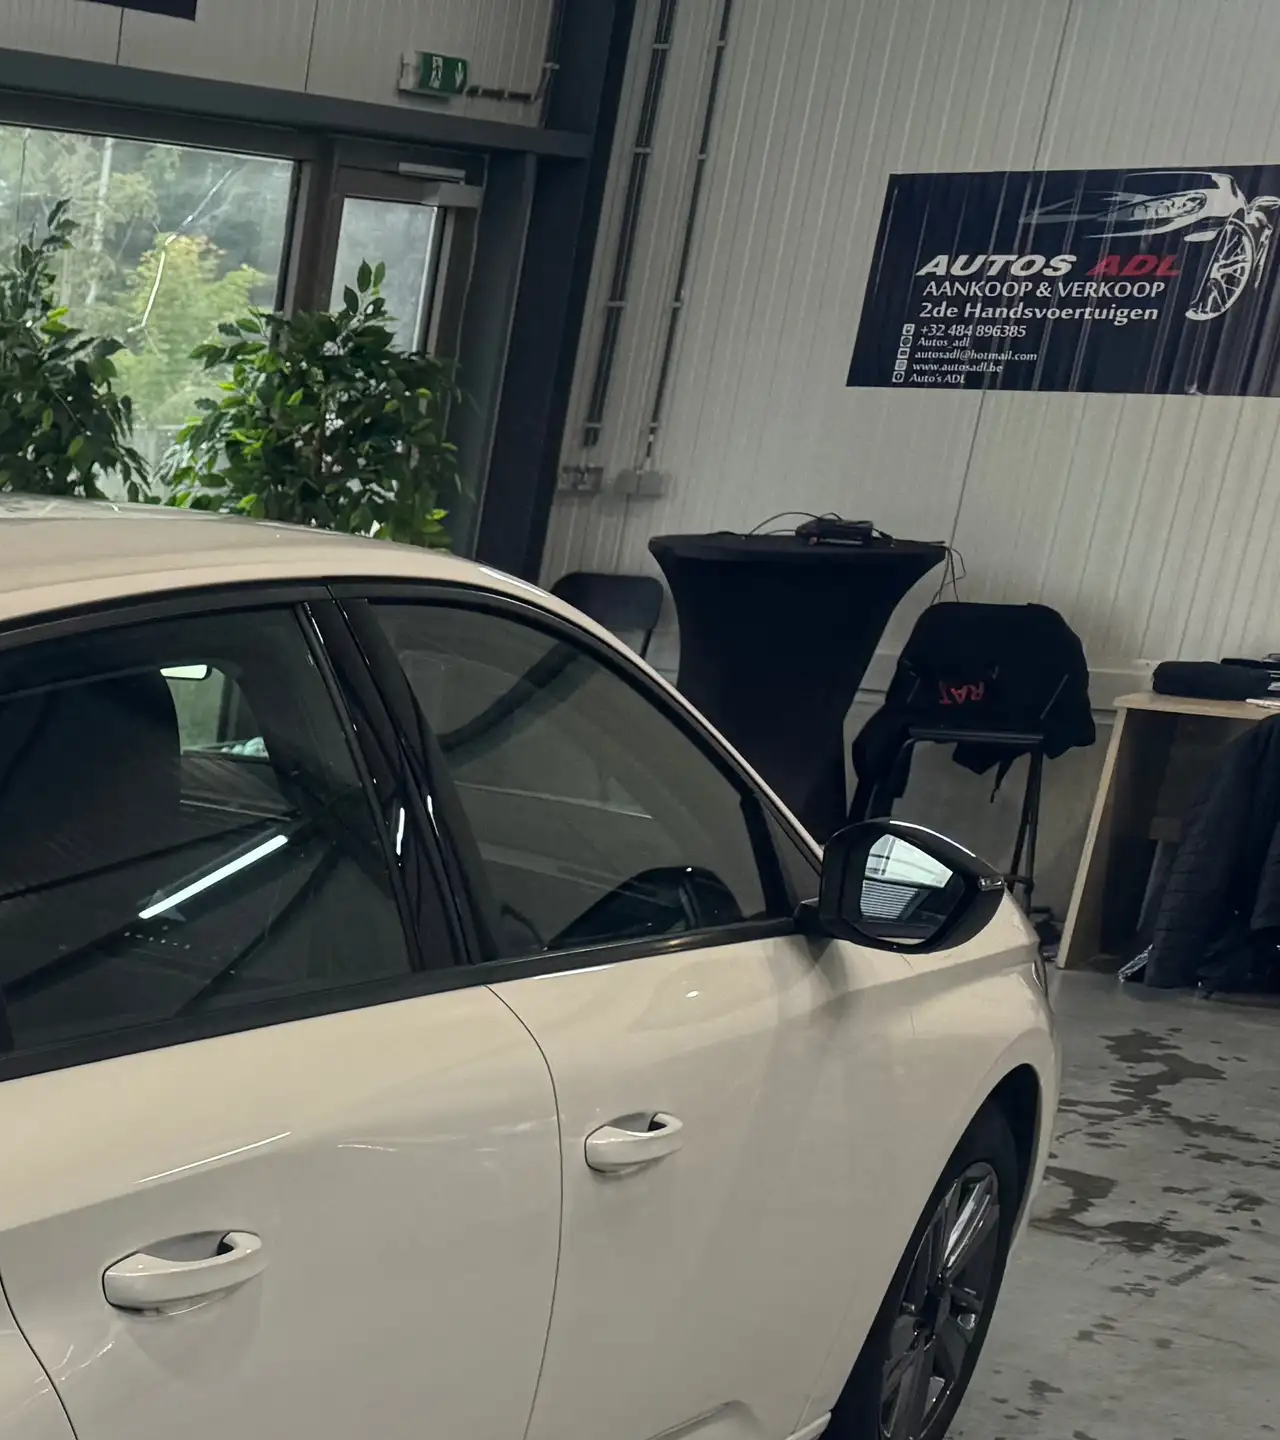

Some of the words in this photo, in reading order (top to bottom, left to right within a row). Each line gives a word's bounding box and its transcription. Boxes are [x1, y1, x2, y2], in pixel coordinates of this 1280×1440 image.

[915, 254, 1078, 277] AUTOS
[1085, 254, 1181, 277] ADL
[923, 281, 1033, 297] AANKOOP
[1036, 281, 1052, 297] &
[1058, 281, 1166, 298] VERKOOP
[919, 301, 959, 318] 2de
[964, 301, 1159, 326] Handsvoertuigen
[920, 325, 945, 337] +32
[948, 325, 973, 337] 484
[975, 325, 1027, 338] 896385
[915, 349, 1038, 361] autosadl@hotmail.com
[913, 362, 1004, 373] www.autosadl.be
[943, 374, 966, 384] ADL
